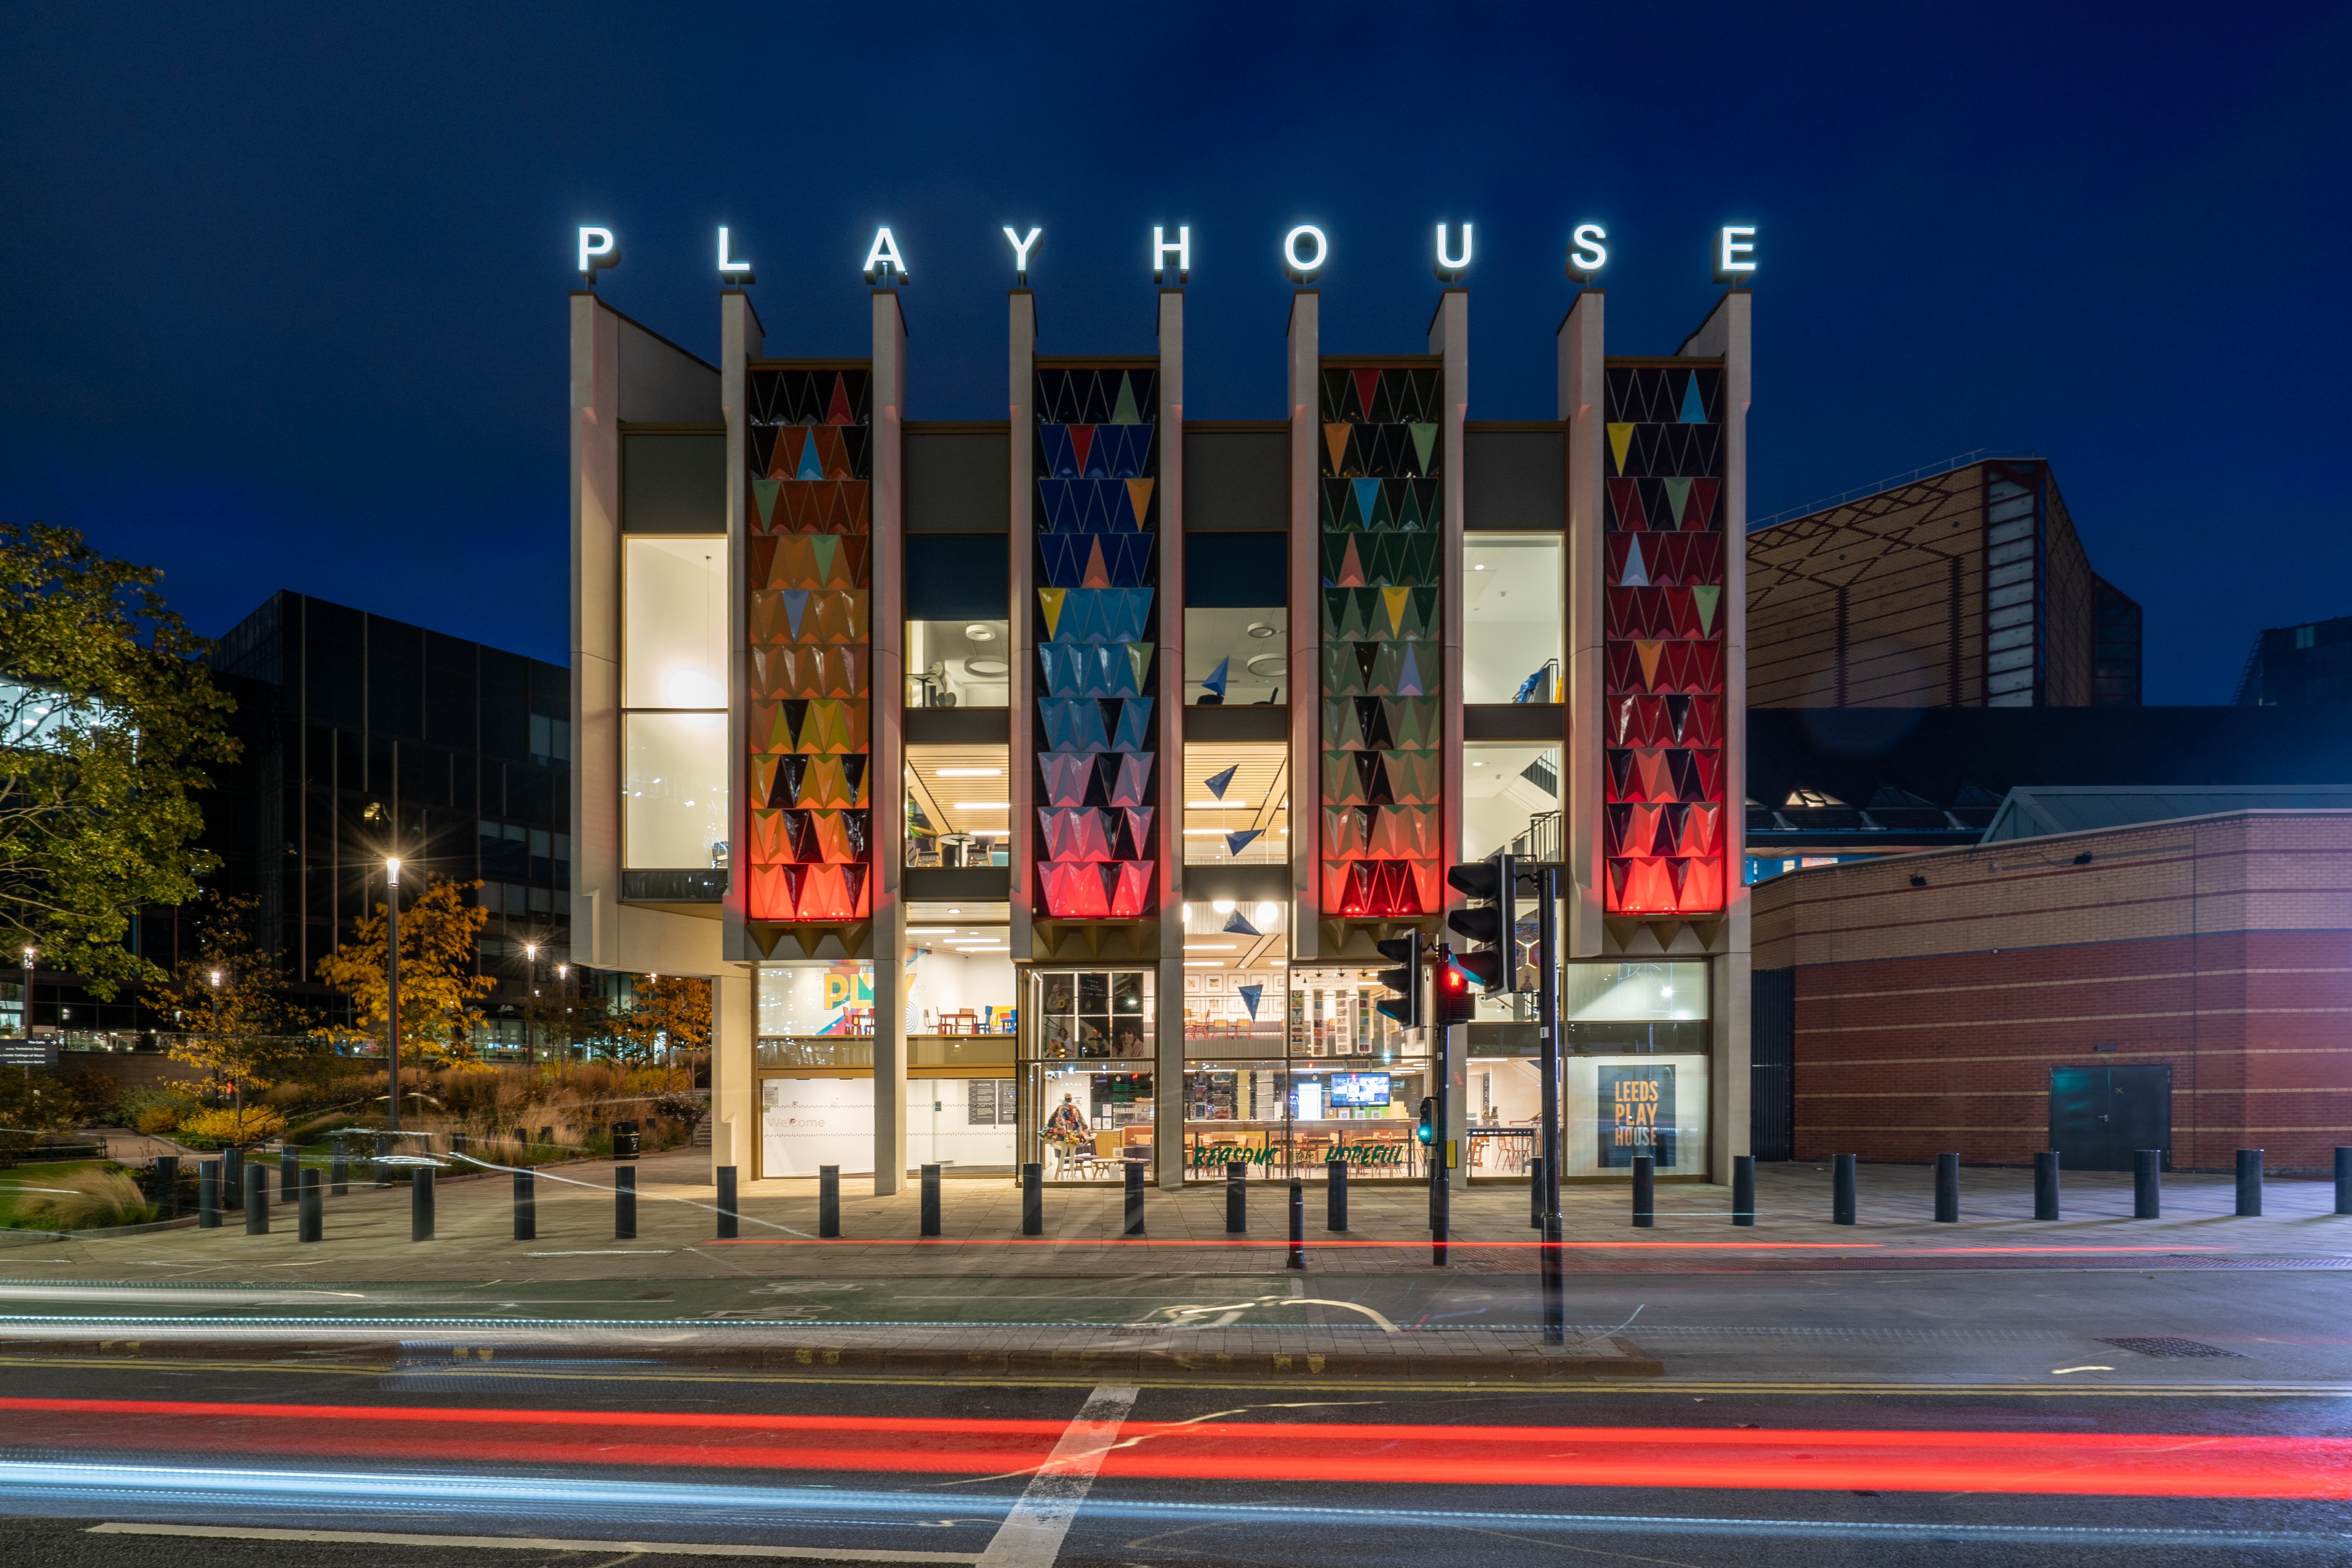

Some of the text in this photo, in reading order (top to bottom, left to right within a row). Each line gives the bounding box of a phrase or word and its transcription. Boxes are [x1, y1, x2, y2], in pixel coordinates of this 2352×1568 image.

[578, 223, 1756, 271] PLAYHOUSE
[1615, 1081, 1659, 1102] LEEDS
[767, 1117, 825, 1128] Welcome
[1615, 1103, 1658, 1126] PLAY
[1615, 1127, 1658, 1146] HOUSE
[1193, 1146, 1278, 1167] REASONS
[1325, 1144, 1403, 1165] HOPEFUL
